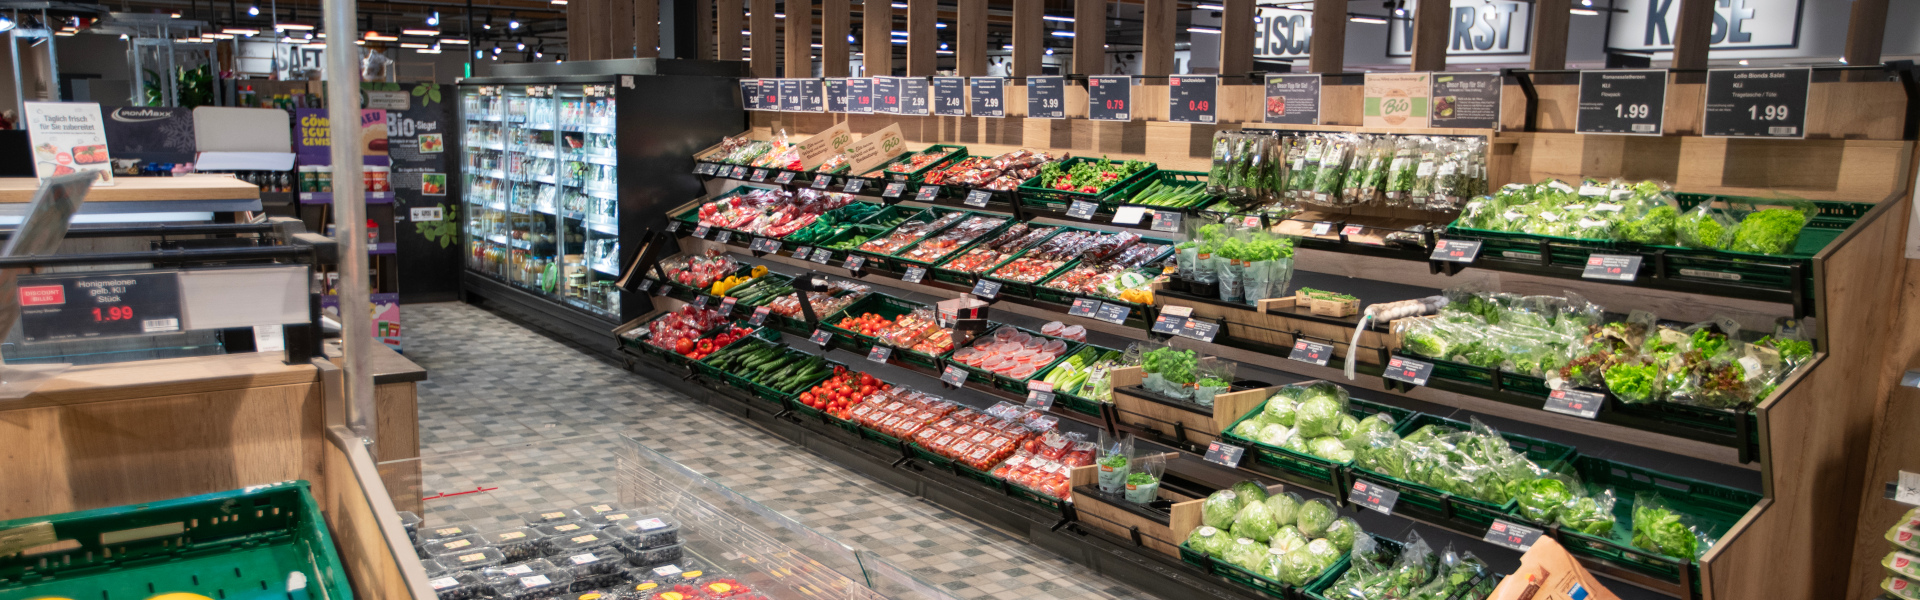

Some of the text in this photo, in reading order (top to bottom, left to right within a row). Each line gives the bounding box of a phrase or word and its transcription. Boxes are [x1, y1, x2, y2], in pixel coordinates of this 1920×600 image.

[1644, 0, 1755, 46] KSE
[278, 45, 323, 72] SAFT
[912, 97, 925, 106] 2.99
[946, 97, 960, 106] 2.49
[984, 98, 999, 107] 2.99
[1042, 98, 1059, 108] 3.99
[1106, 99, 1124, 110] 0.79
[1189, 100, 1209, 111] 0.49
[1382, 98, 1409, 115] Bio
[1614, 103, 1649, 118] 1.99
[1748, 104, 1788, 121] 1.99
[44, 114, 88, 123] Täglich frisch
[63, 123, 95, 131] zubereitet
[831, 133, 849, 150] Bio
[881, 136, 900, 153] Bio
[78, 279, 137, 290] Honigmelonen
[25, 289, 60, 297] DISCOUNT
[97, 294, 122, 303] Stück
[92, 305, 134, 322] 1.99
